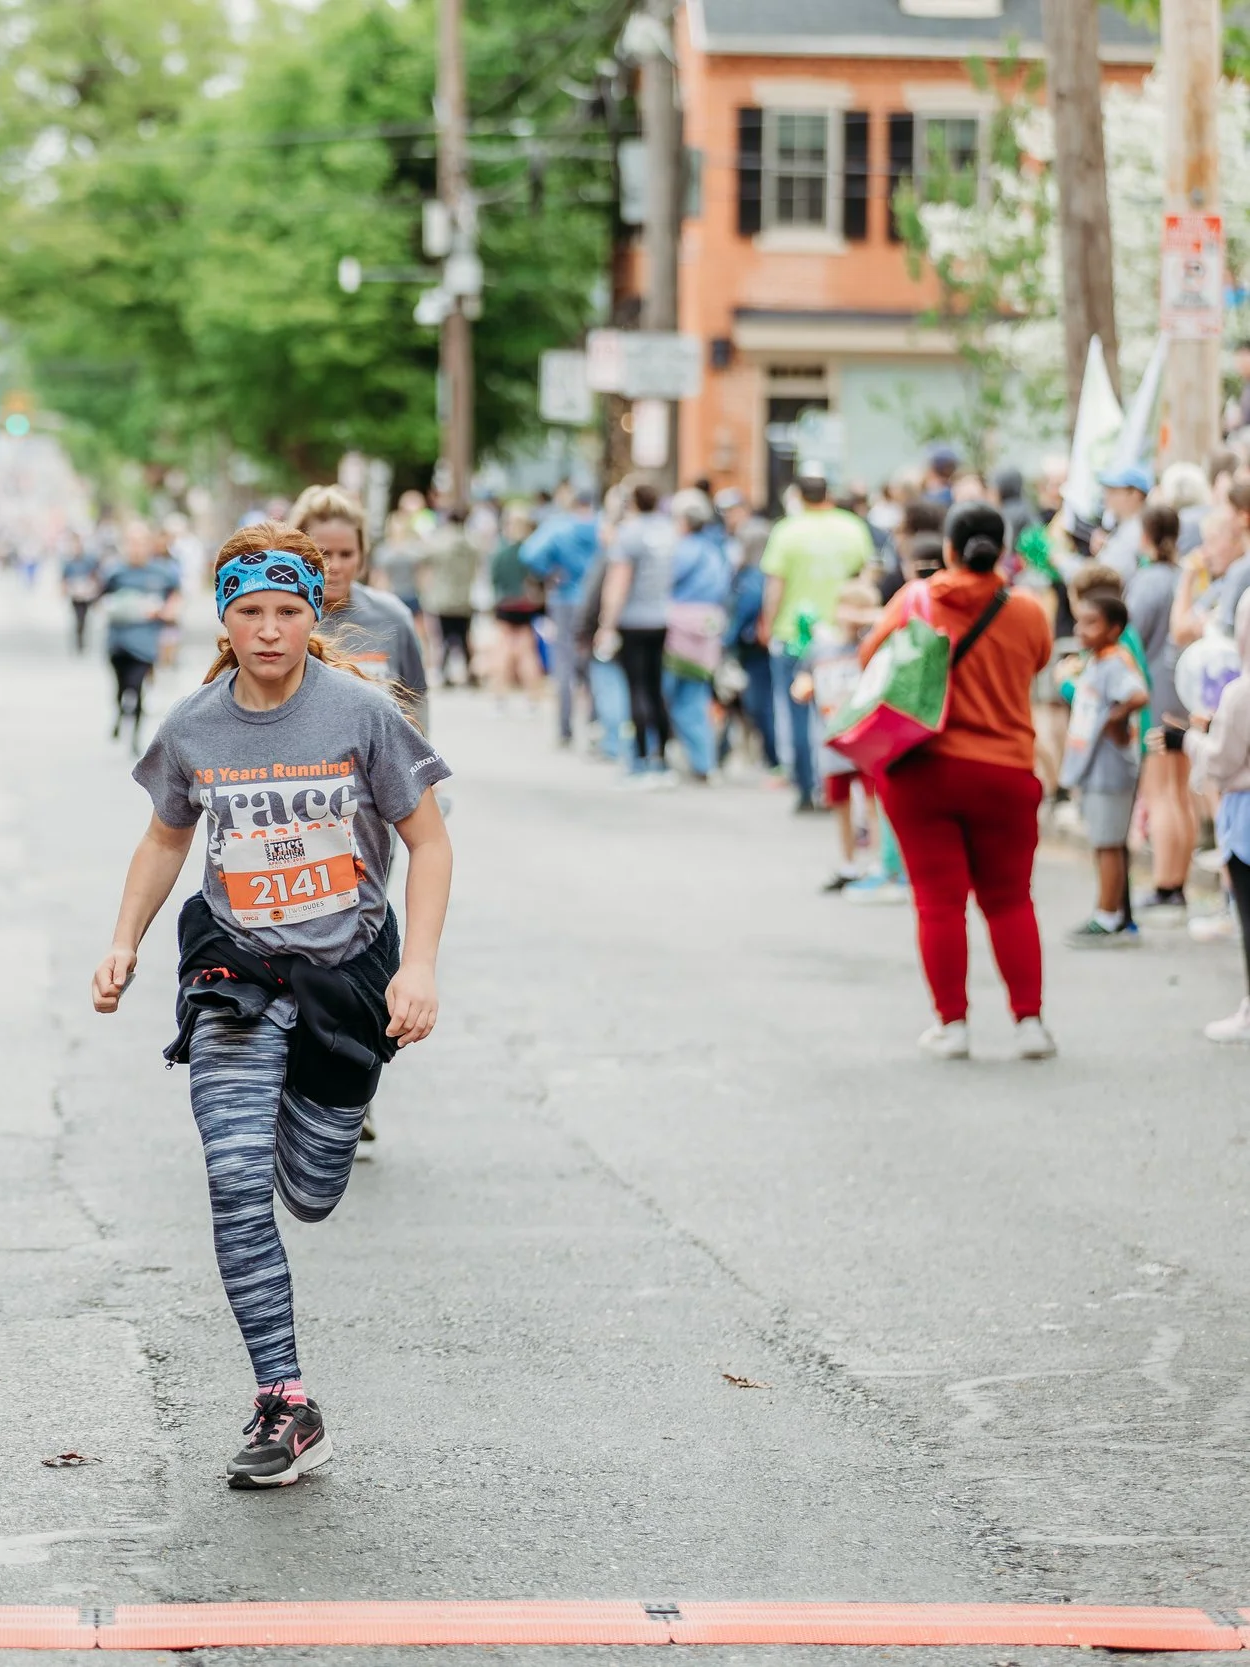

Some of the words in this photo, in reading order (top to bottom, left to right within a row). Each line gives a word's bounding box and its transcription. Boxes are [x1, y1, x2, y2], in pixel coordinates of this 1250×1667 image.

[219, 767, 268, 782] Years
[273, 755, 355, 780] Running!
[214, 784, 358, 829] race
[270, 840, 303, 854] race
[270, 848, 306, 862] RACISM
[250, 864, 332, 906] 2141
